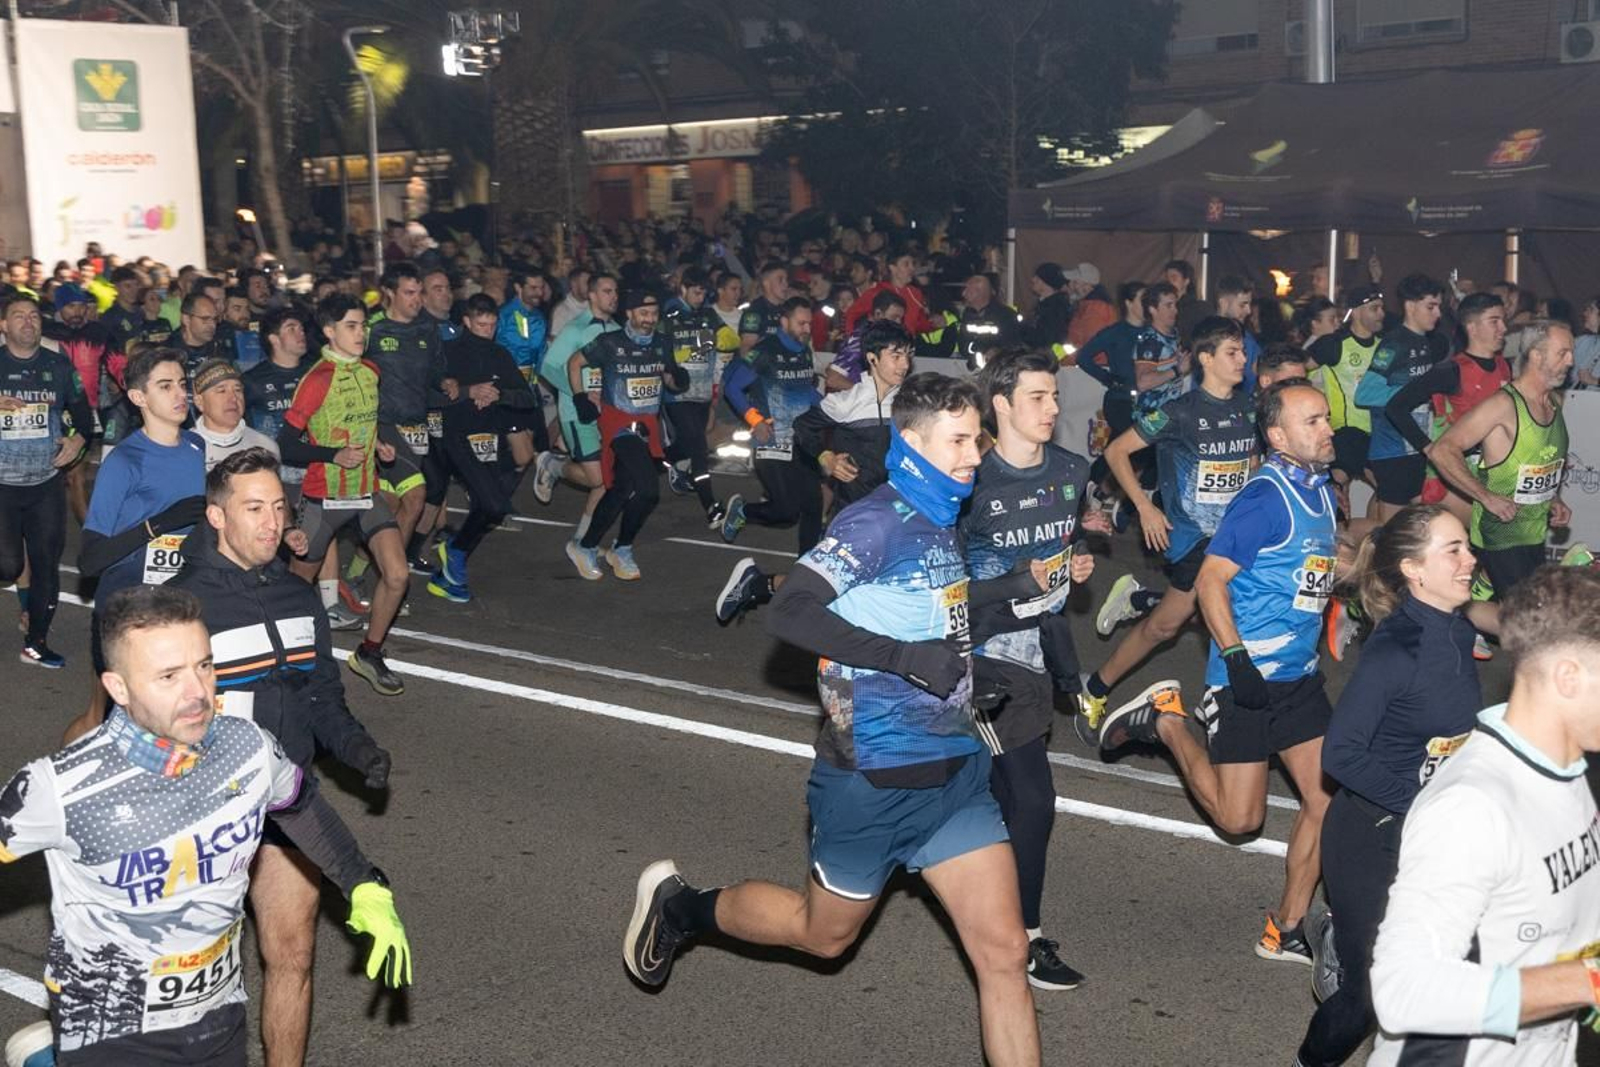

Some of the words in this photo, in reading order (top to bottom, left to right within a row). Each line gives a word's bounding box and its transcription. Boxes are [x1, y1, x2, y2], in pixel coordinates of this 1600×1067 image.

[617, 363, 638, 374] SAN
[1199, 441, 1226, 455] SAN
[1203, 471, 1245, 488] 5586
[1522, 471, 1557, 489] 5981
[992, 527, 1029, 548] SAN
[159, 944, 234, 1002] 9451
